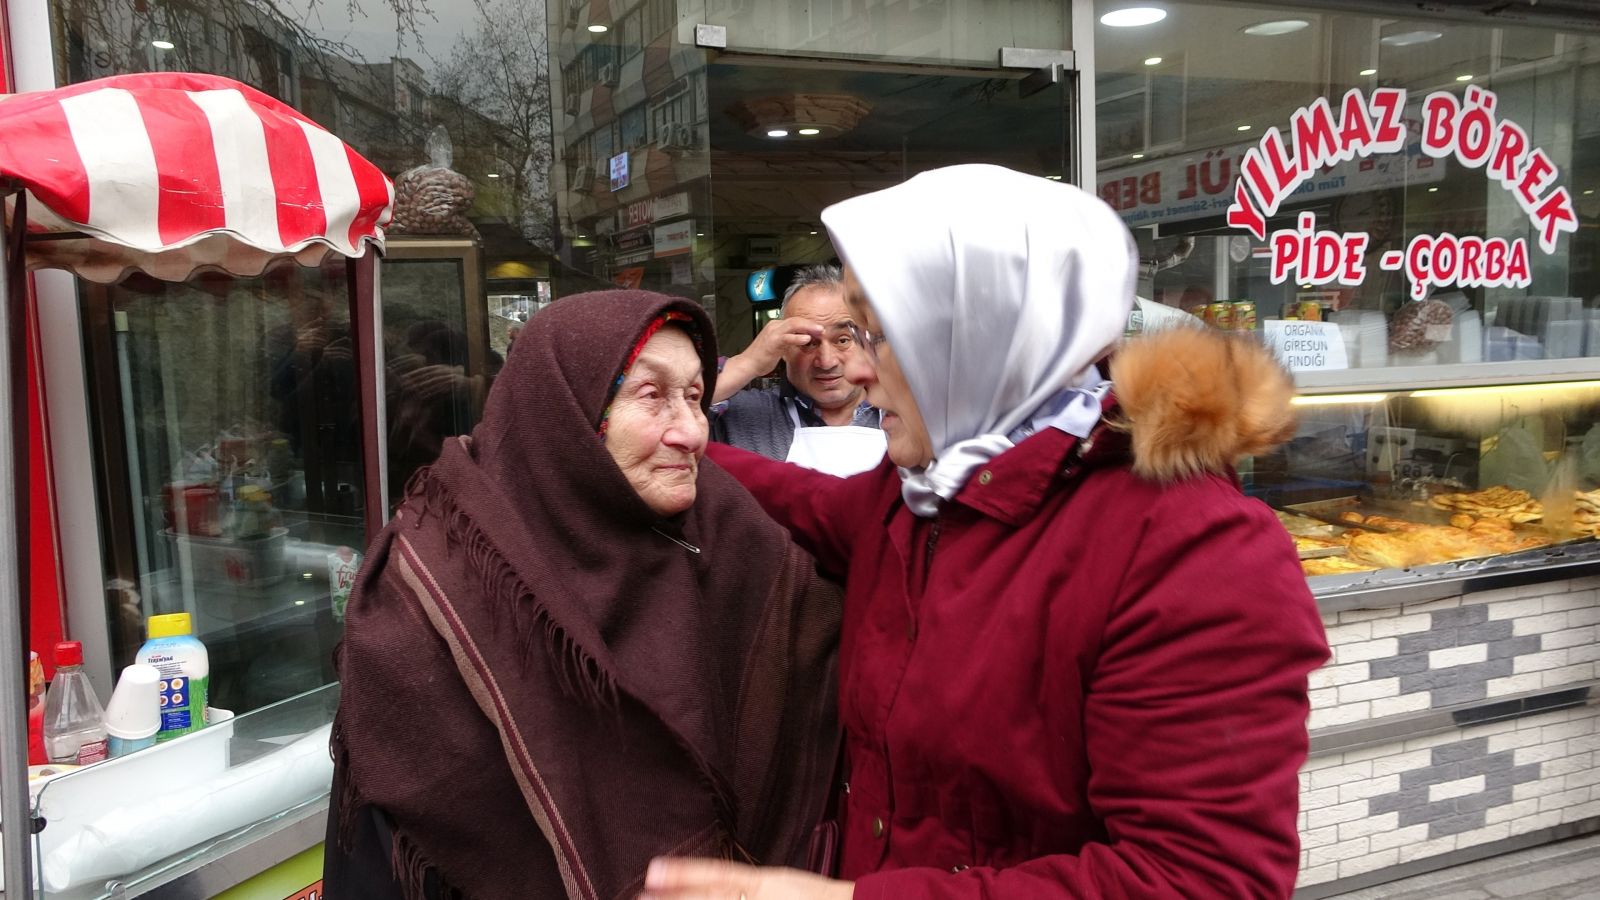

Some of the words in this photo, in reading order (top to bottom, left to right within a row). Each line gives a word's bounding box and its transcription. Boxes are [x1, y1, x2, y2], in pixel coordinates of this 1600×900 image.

[1227, 88, 1406, 241] YILMAZ
[1421, 84, 1578, 254] BÖREK
[1270, 212, 1369, 285] PİDE
[1406, 233, 1531, 300] ÇORBA
[1288, 354, 1325, 367] FINDIĞI
